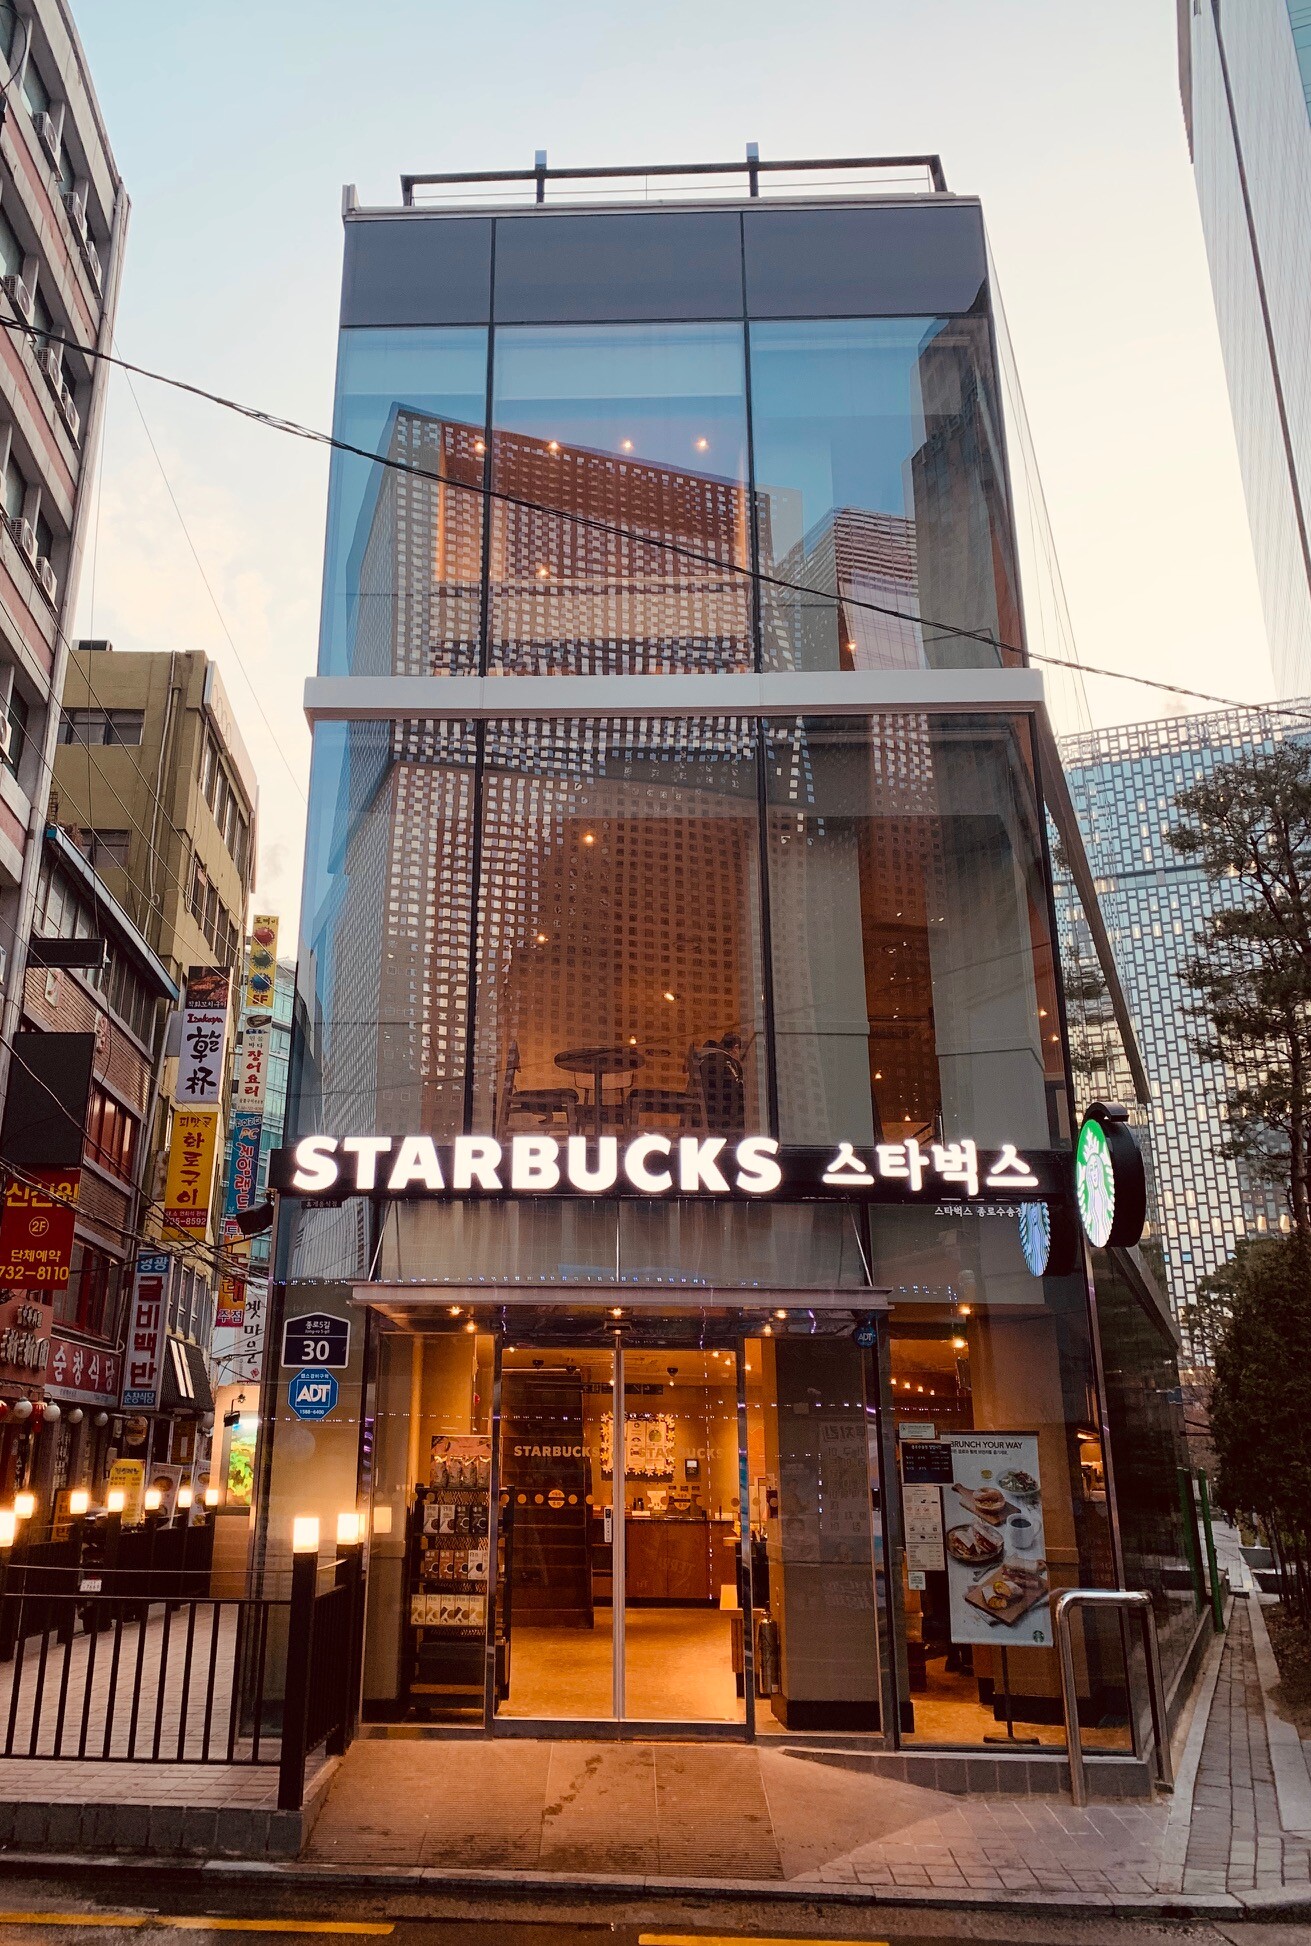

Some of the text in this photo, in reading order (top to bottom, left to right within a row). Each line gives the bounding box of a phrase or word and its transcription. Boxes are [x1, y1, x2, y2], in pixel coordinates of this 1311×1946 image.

[244, 1050, 264, 1097] 장어요리
[239, 1127, 260, 1140] PC
[176, 1131, 205, 1206] 화로구이
[292, 1134, 782, 1193] STARBUCKS
[822, 1138, 1039, 1196] 스타벅스
[234, 1142, 255, 1210] 게임랜드
[934, 1205, 973, 1217] 스타벅스
[31, 1221, 47, 1232] 2F
[11, 1249, 62, 1263] 단체예약
[140, 1256, 169, 1271] 영광
[0, 1265, 70, 1281] 732-8110
[217, 1308, 244, 1324] 주점
[130, 1275, 164, 1389] 굴비백반
[305, 1320, 331, 1330] 종로5길
[858, 1332, 873, 1341] ADT
[301, 1340, 330, 1361] 30
[53, 1344, 115, 1392] 순창식당
[124, 1392, 155, 1405] 순창식당
[296, 1384, 331, 1403] ADT
[514, 1445, 601, 1458] STARBUCKS
[950, 1440, 1023, 1450] BRUNCH YOUR WAY
